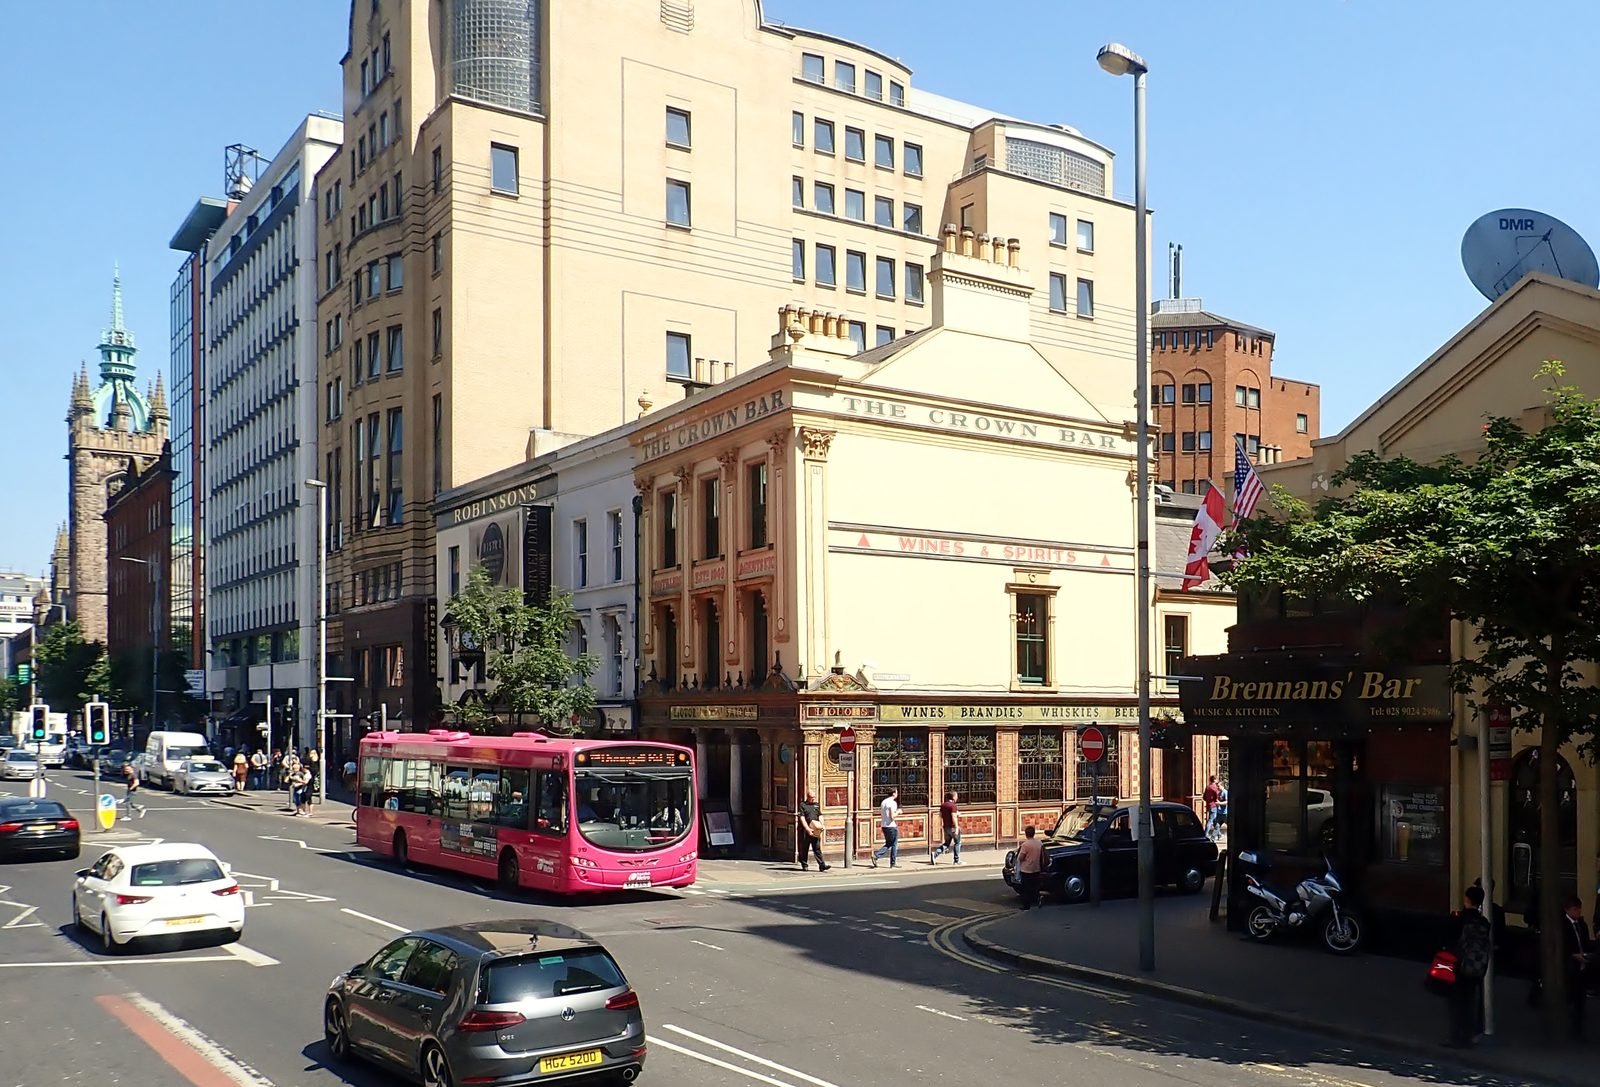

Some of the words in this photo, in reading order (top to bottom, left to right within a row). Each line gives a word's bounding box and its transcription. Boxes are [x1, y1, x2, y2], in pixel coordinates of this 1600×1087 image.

[1499, 218, 1534, 231] DMR
[642, 436, 670, 461] THE
[678, 407, 738, 447] CROWN
[745, 390, 784, 420] BAR
[843, 396, 907, 418] THE
[929, 410, 1038, 437] CROWN
[1059, 429, 1117, 448] BAR
[454, 484, 537, 523] ROBINSON'S
[900, 537, 964, 554] WINES
[981, 546, 989, 558] &
[1004, 546, 1076, 563] SPIRITS
[1209, 672, 1353, 700] Brennans'
[1358, 672, 1421, 699] Bar
[1193, 708, 1223, 716] MUSIC
[1225, 708, 1232, 716] &
[1235, 708, 1280, 716] KITCHEN
[1369, 707, 1383, 716] Tel:
[1386, 708, 1399, 716] 028
[545, 1055, 566, 1069] HGZ
[569, 1052, 596, 1065] 5200
